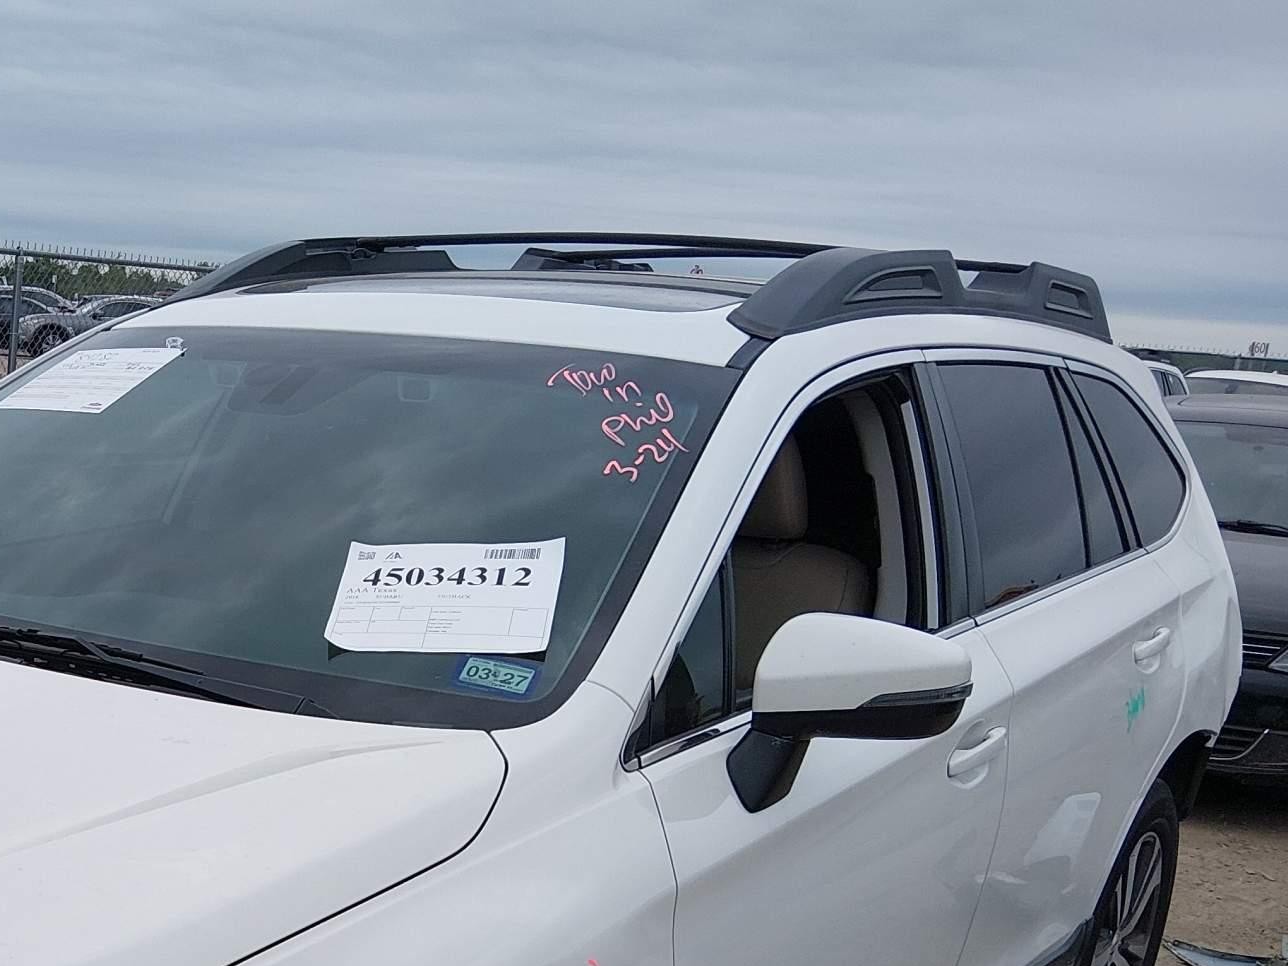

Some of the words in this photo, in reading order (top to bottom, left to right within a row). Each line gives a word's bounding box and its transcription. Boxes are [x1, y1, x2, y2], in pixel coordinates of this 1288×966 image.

[362, 566, 532, 587] 45034312
[466, 665, 492, 680] 03
[500, 672, 529, 688] 27
